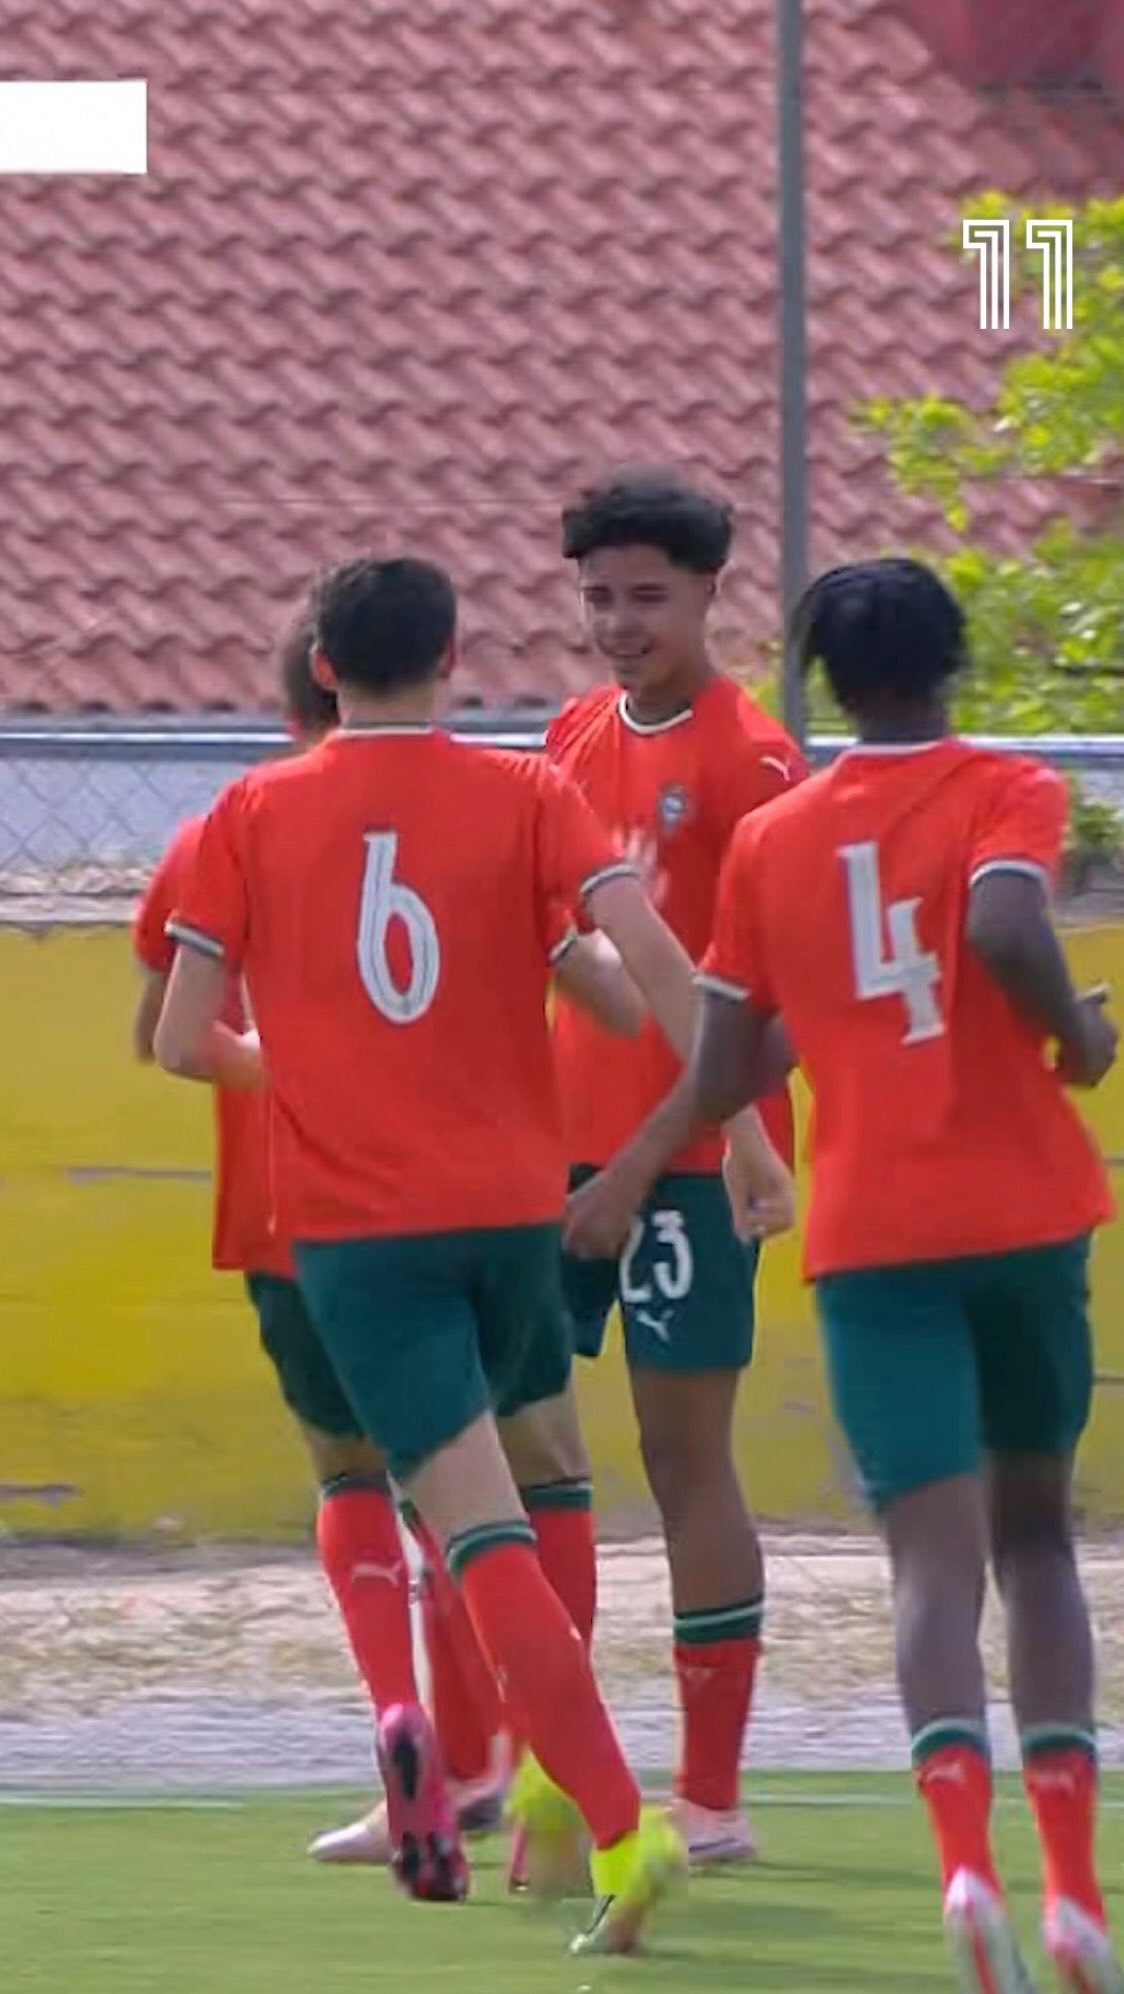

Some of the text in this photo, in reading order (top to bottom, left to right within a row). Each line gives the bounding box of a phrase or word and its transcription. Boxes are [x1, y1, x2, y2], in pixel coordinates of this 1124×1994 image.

[357, 831, 440, 1023] 6
[835, 841, 945, 1045] 4
[619, 1208, 694, 1302] 23
